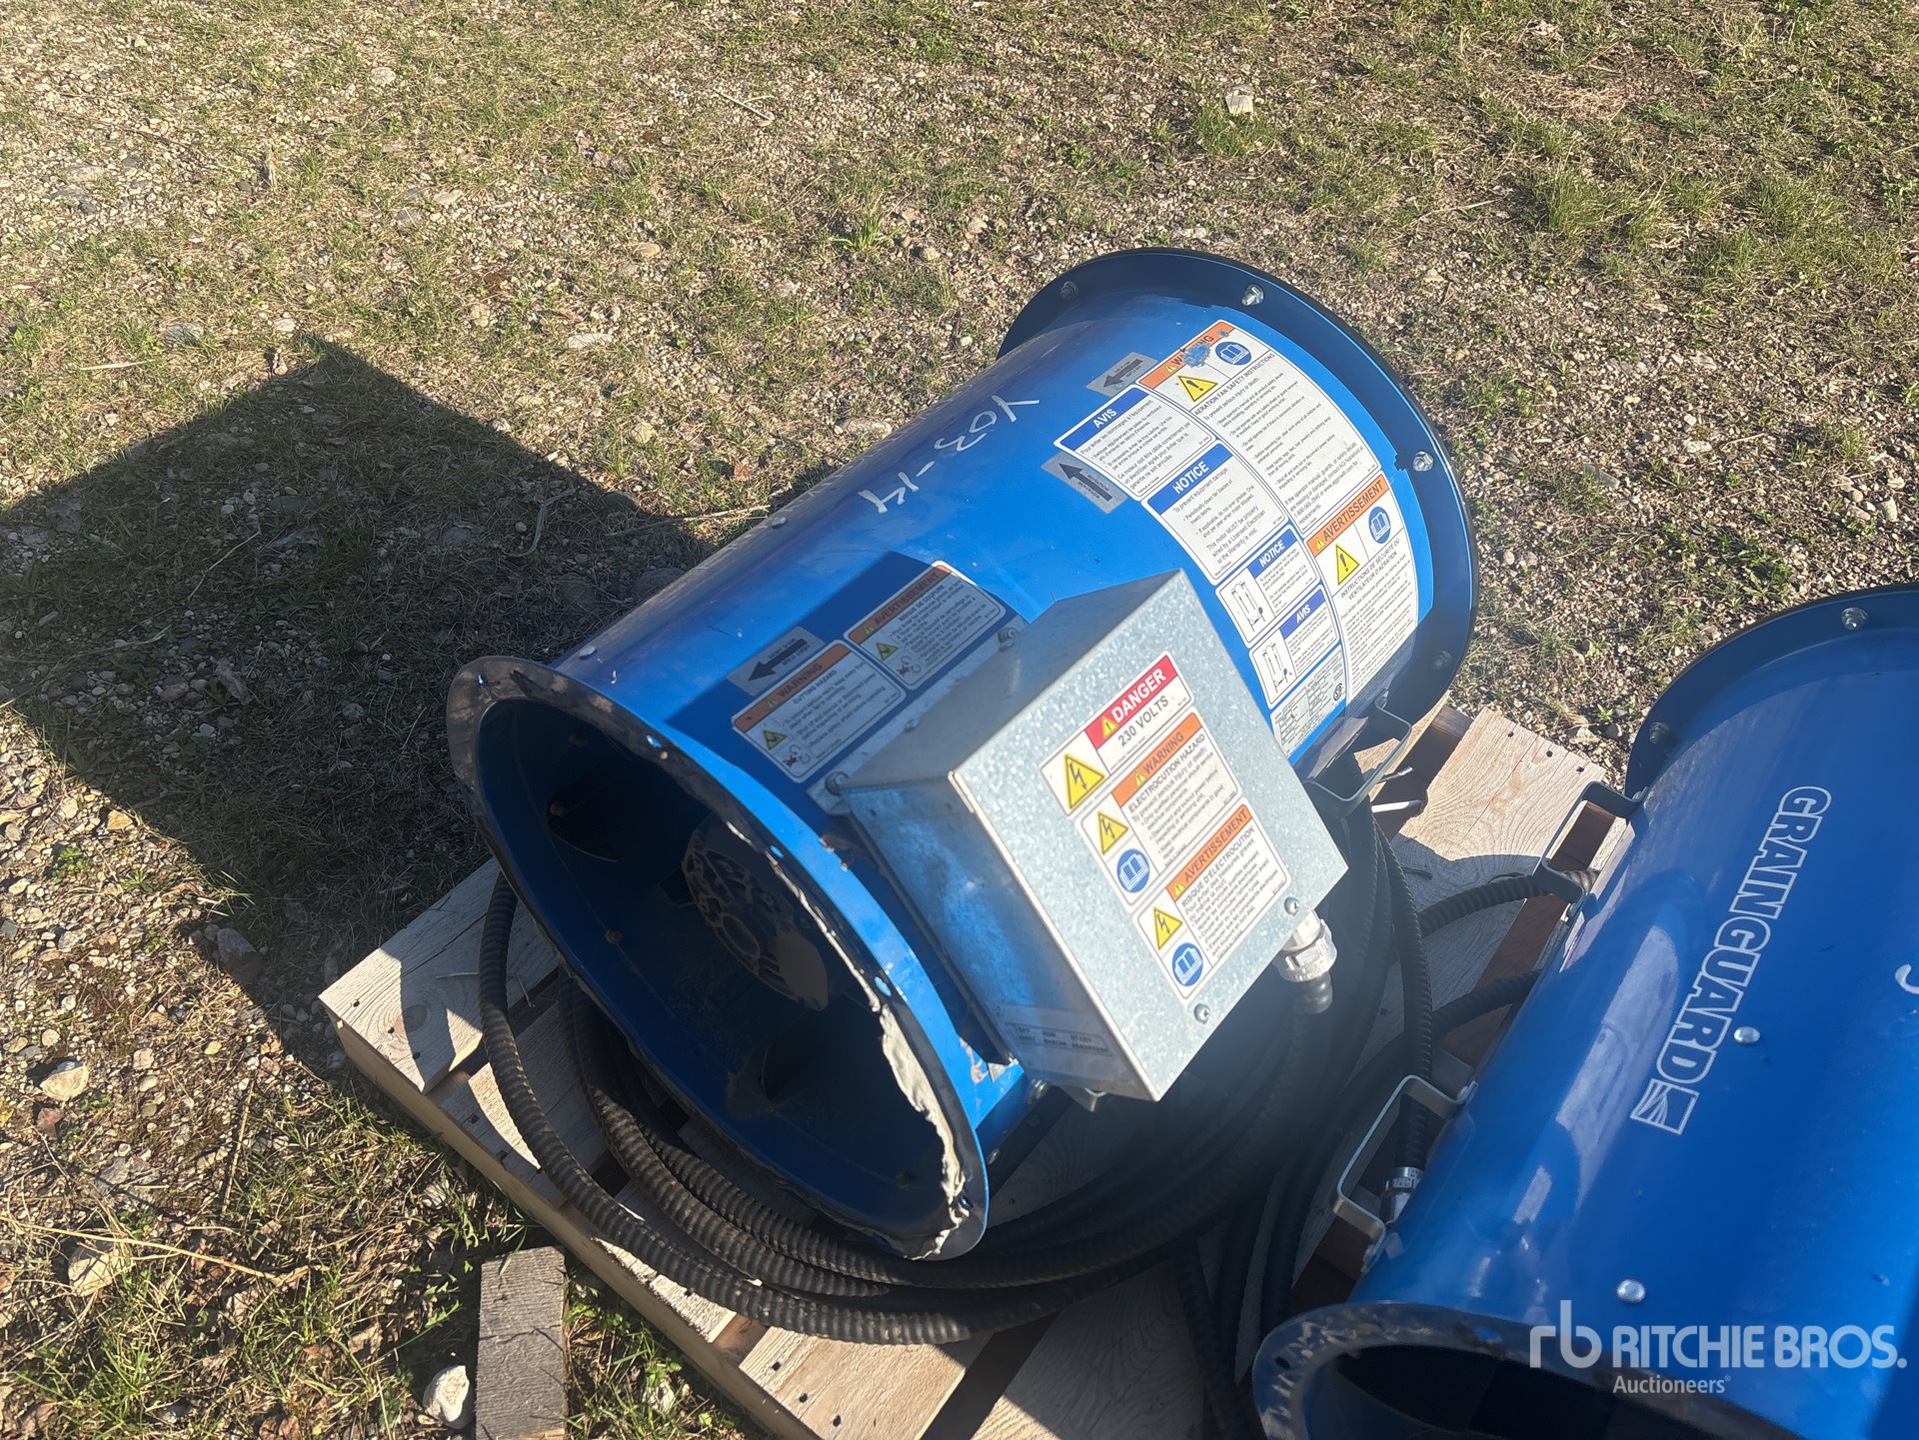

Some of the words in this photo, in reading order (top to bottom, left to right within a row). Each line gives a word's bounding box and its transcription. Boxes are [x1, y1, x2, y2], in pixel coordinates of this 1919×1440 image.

[1194, 396, 1218, 416] AERATION
[1217, 388, 1228, 398] FAN
[1226, 376, 1245, 391] SAFETY
[1243, 352, 1275, 378] INSTRUCTIONS
[1091, 408, 1118, 428] AVIS
[1172, 461, 1210, 494] NOTICE
[1207, 541, 1217, 550] This
[1215, 532, 1227, 543] motor
[1226, 521, 1240, 534] MUST
[1242, 505, 1260, 521] properly
[1211, 546, 1224, 557] wired
[1230, 525, 1248, 541] Licensed
[1246, 510, 1266, 527] Electrician
[1321, 480, 1384, 541] AVERTISSEMENT
[1259, 539, 1286, 567] NOTICE
[873, 573, 939, 625] AVERTISSEMENT
[1295, 604, 1311, 624] AVIS
[776, 662, 823, 699] WARNING
[1110, 666, 1167, 724] DANGER
[1118, 724, 1137, 747] 230
[1135, 694, 1169, 730] VOLTS
[1128, 757, 1181, 813] ELECTROCUTION
[1180, 733, 1205, 761] HAZARD
[1143, 731, 1185, 775] WARNING
[1182, 809, 1249, 882] AVERTISSEMENT
[1181, 881, 1204, 908] RISQUE
[1657, 786, 1832, 1084] GRAINGUARD
